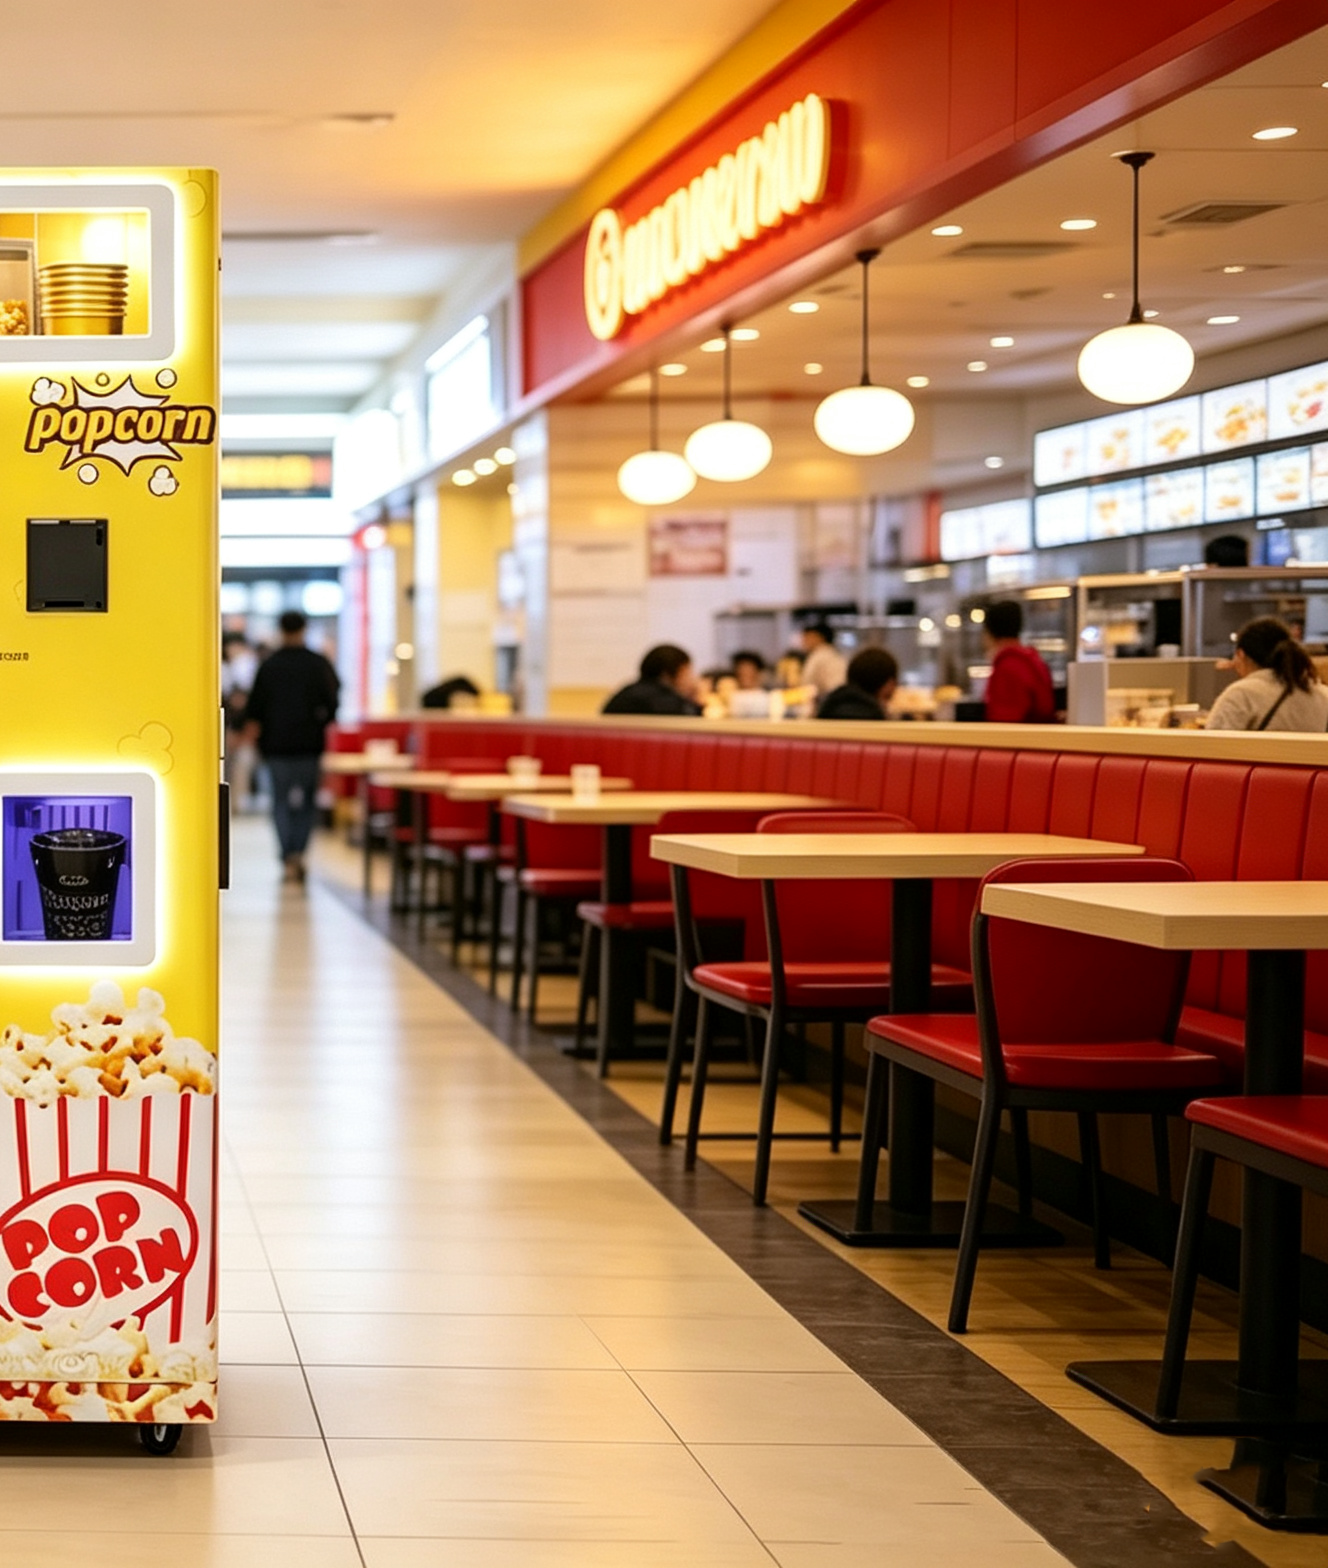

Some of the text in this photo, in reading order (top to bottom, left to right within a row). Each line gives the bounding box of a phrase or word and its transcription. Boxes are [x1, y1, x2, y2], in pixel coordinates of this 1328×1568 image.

[26, 405, 215, 453] popcorn
[2, 1190, 140, 1271] POP
[8, 1228, 185, 1318] CORN
